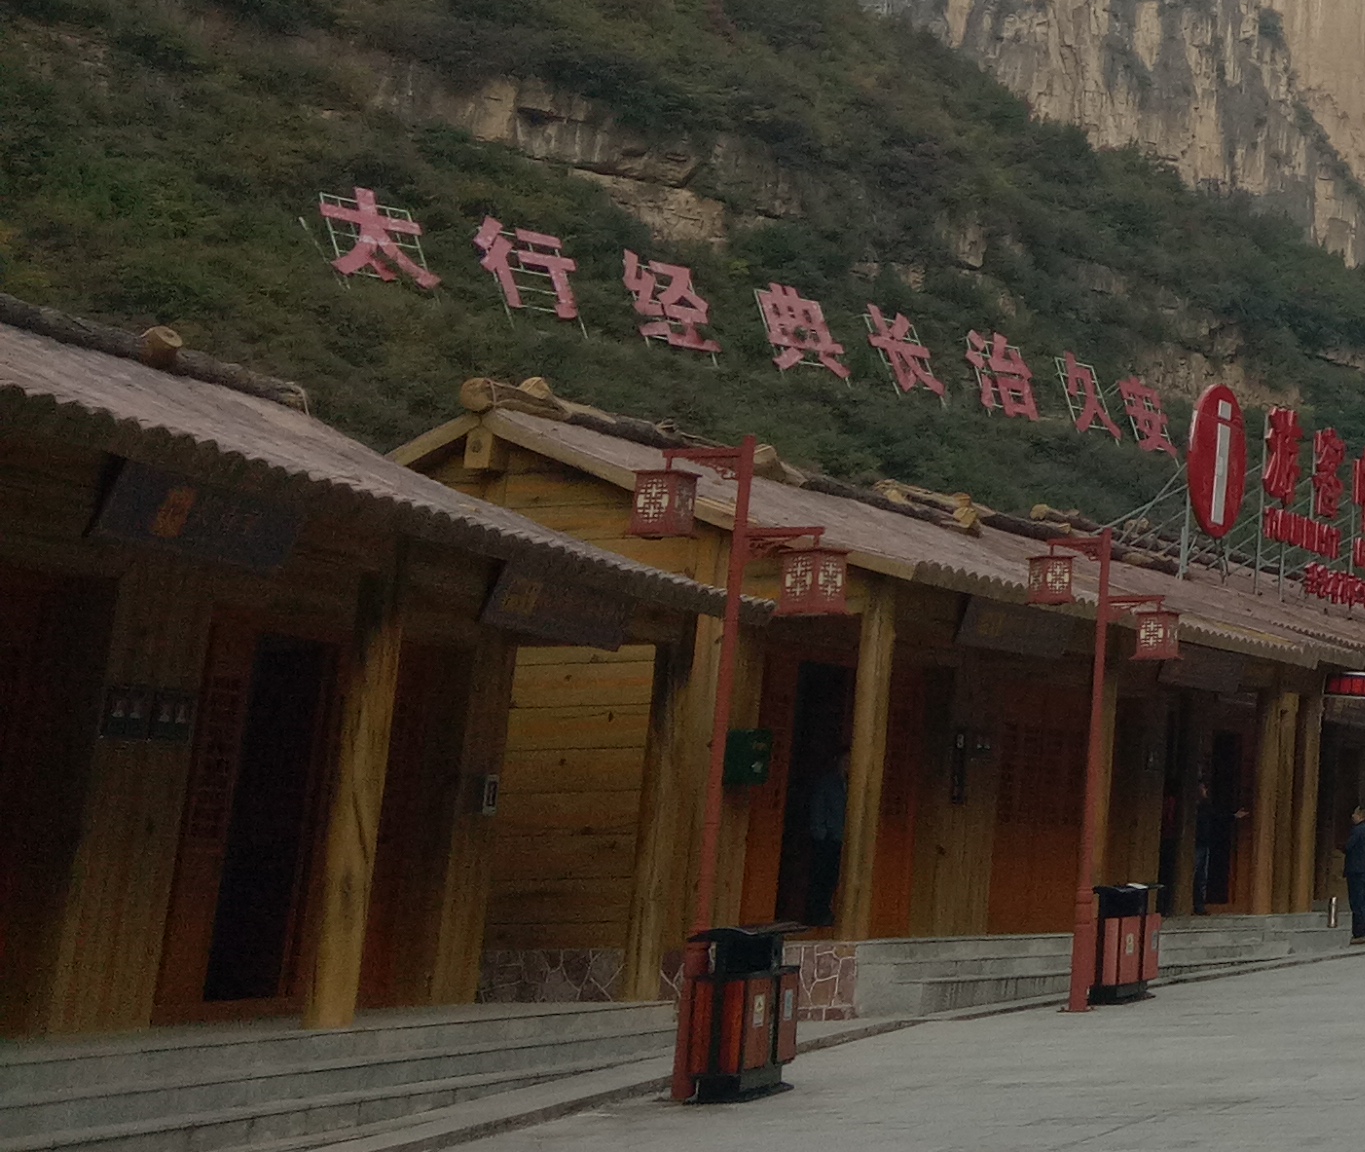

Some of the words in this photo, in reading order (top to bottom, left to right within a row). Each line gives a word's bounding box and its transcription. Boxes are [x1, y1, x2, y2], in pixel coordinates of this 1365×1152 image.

[319, 187, 1178, 456] 太行经典长治久安
